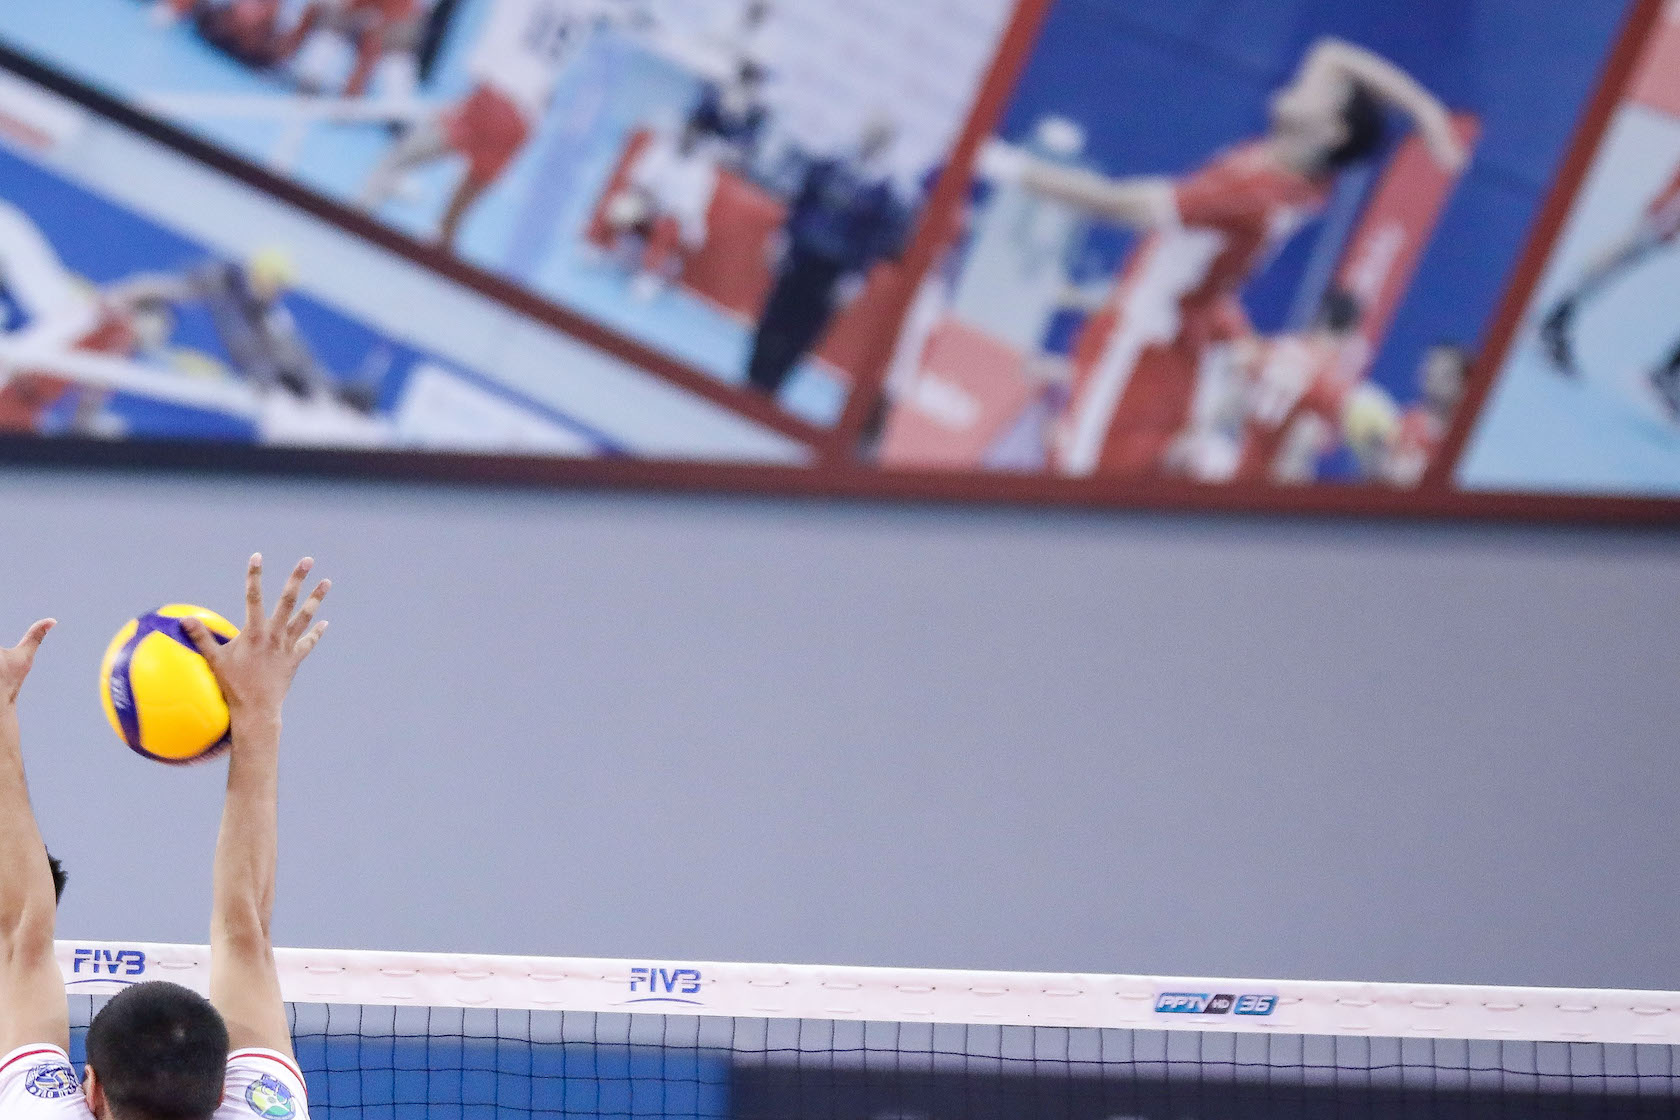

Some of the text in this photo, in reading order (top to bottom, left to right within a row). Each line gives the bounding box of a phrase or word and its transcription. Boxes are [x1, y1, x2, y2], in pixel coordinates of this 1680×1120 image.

[73, 949, 146, 975] FIVB
[630, 967, 701, 993] FIVB
[1238, 996, 1274, 1012] 36
